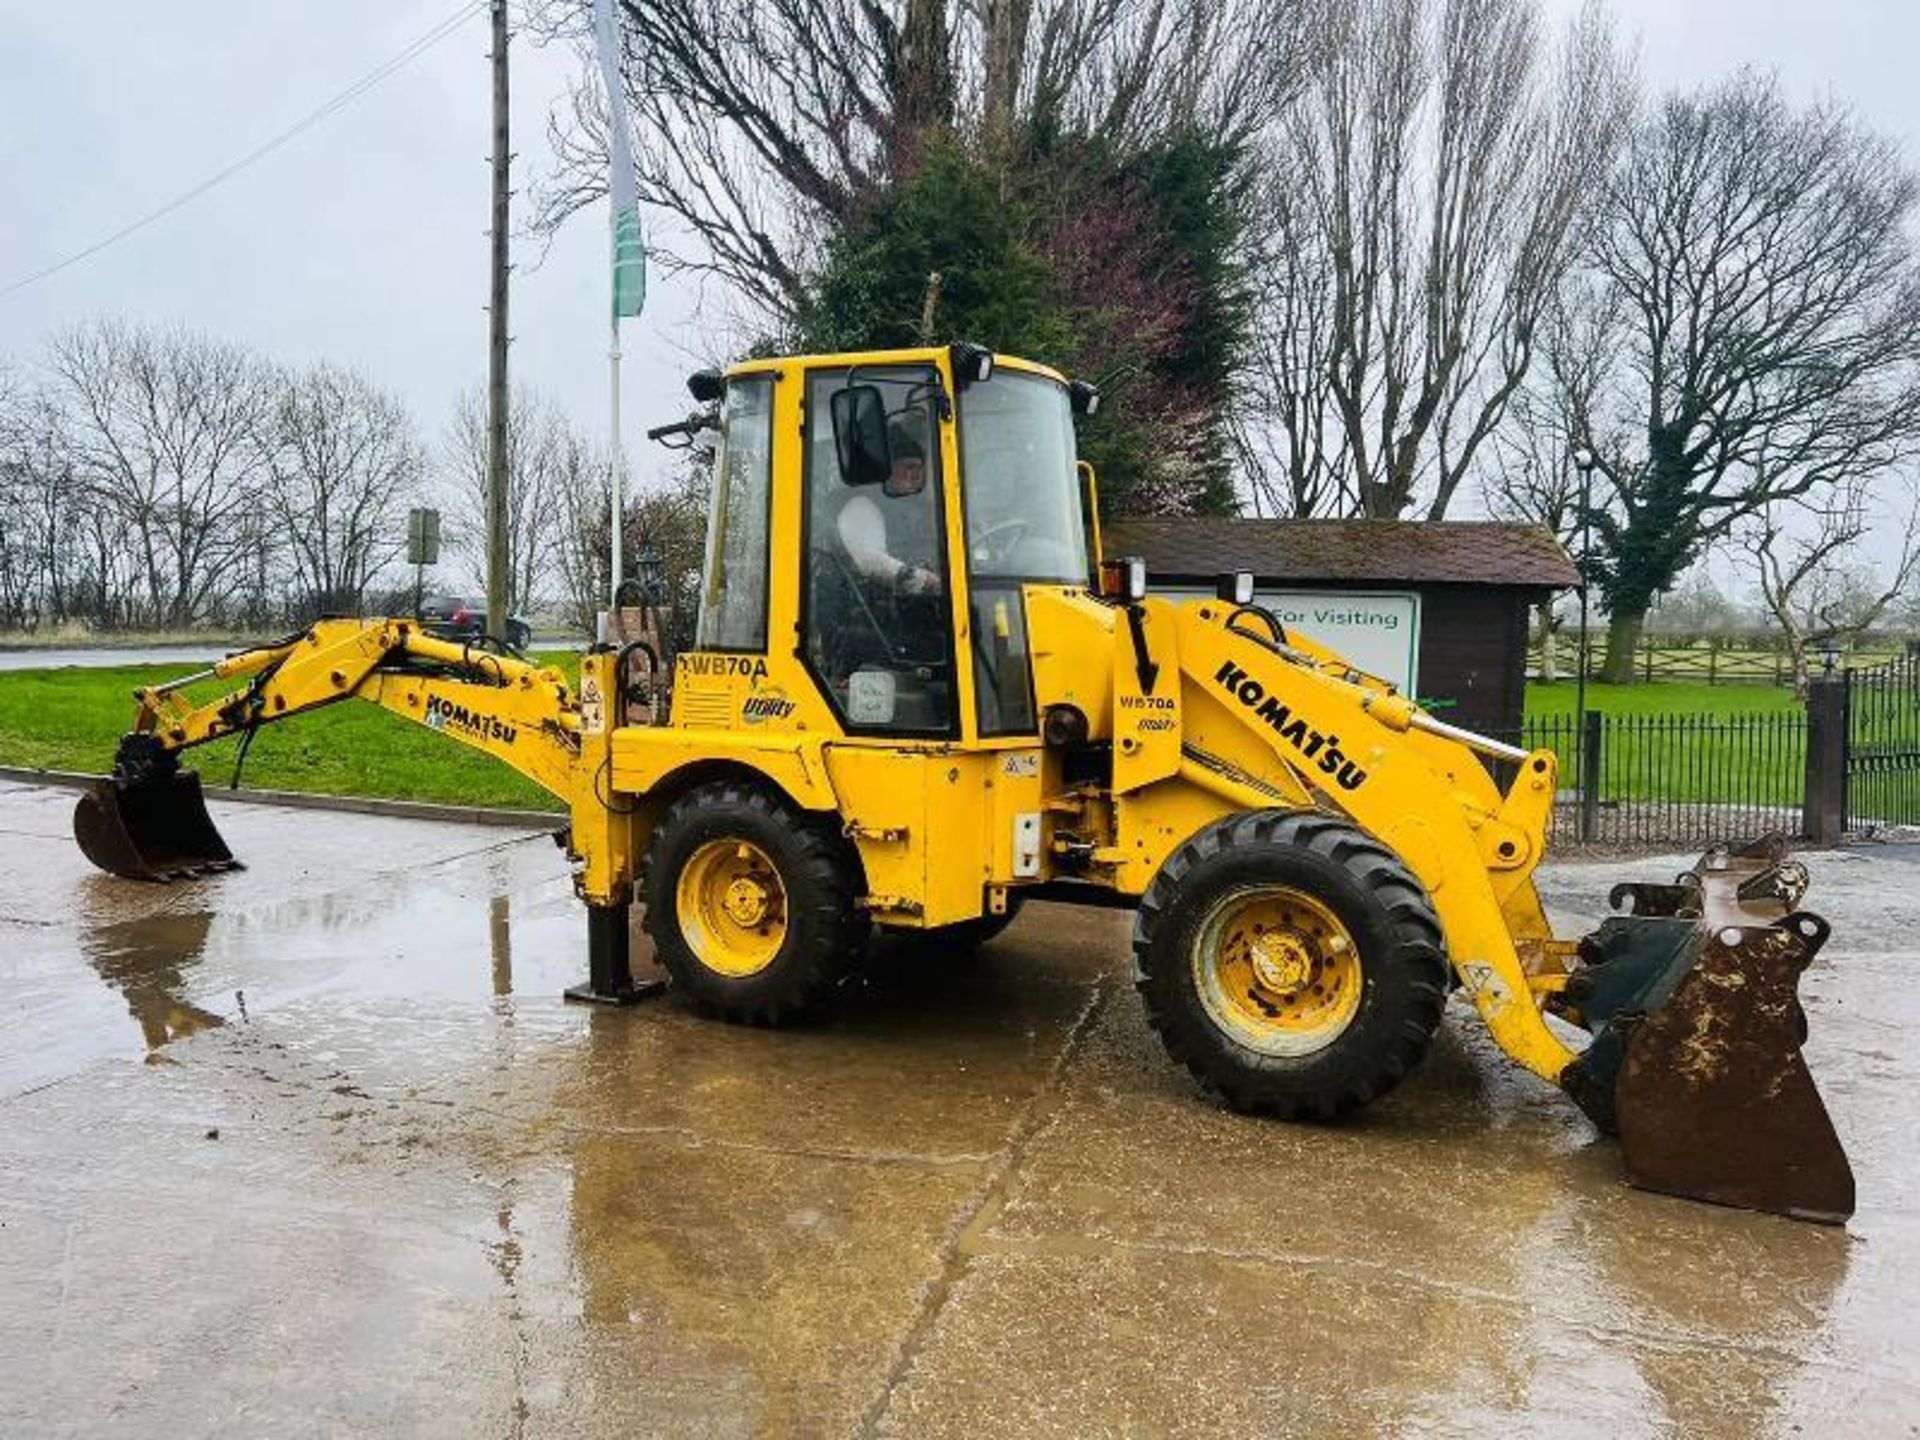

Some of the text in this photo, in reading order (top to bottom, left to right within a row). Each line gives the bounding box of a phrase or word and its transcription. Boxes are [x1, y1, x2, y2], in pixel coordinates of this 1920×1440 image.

[1314, 608, 1398, 630] Visiting
[691, 655, 769, 678] WB70A
[1120, 696, 1175, 709] WB70A
[427, 693, 517, 743] KOMATSU
[1213, 659, 1367, 790] KOMATSU
